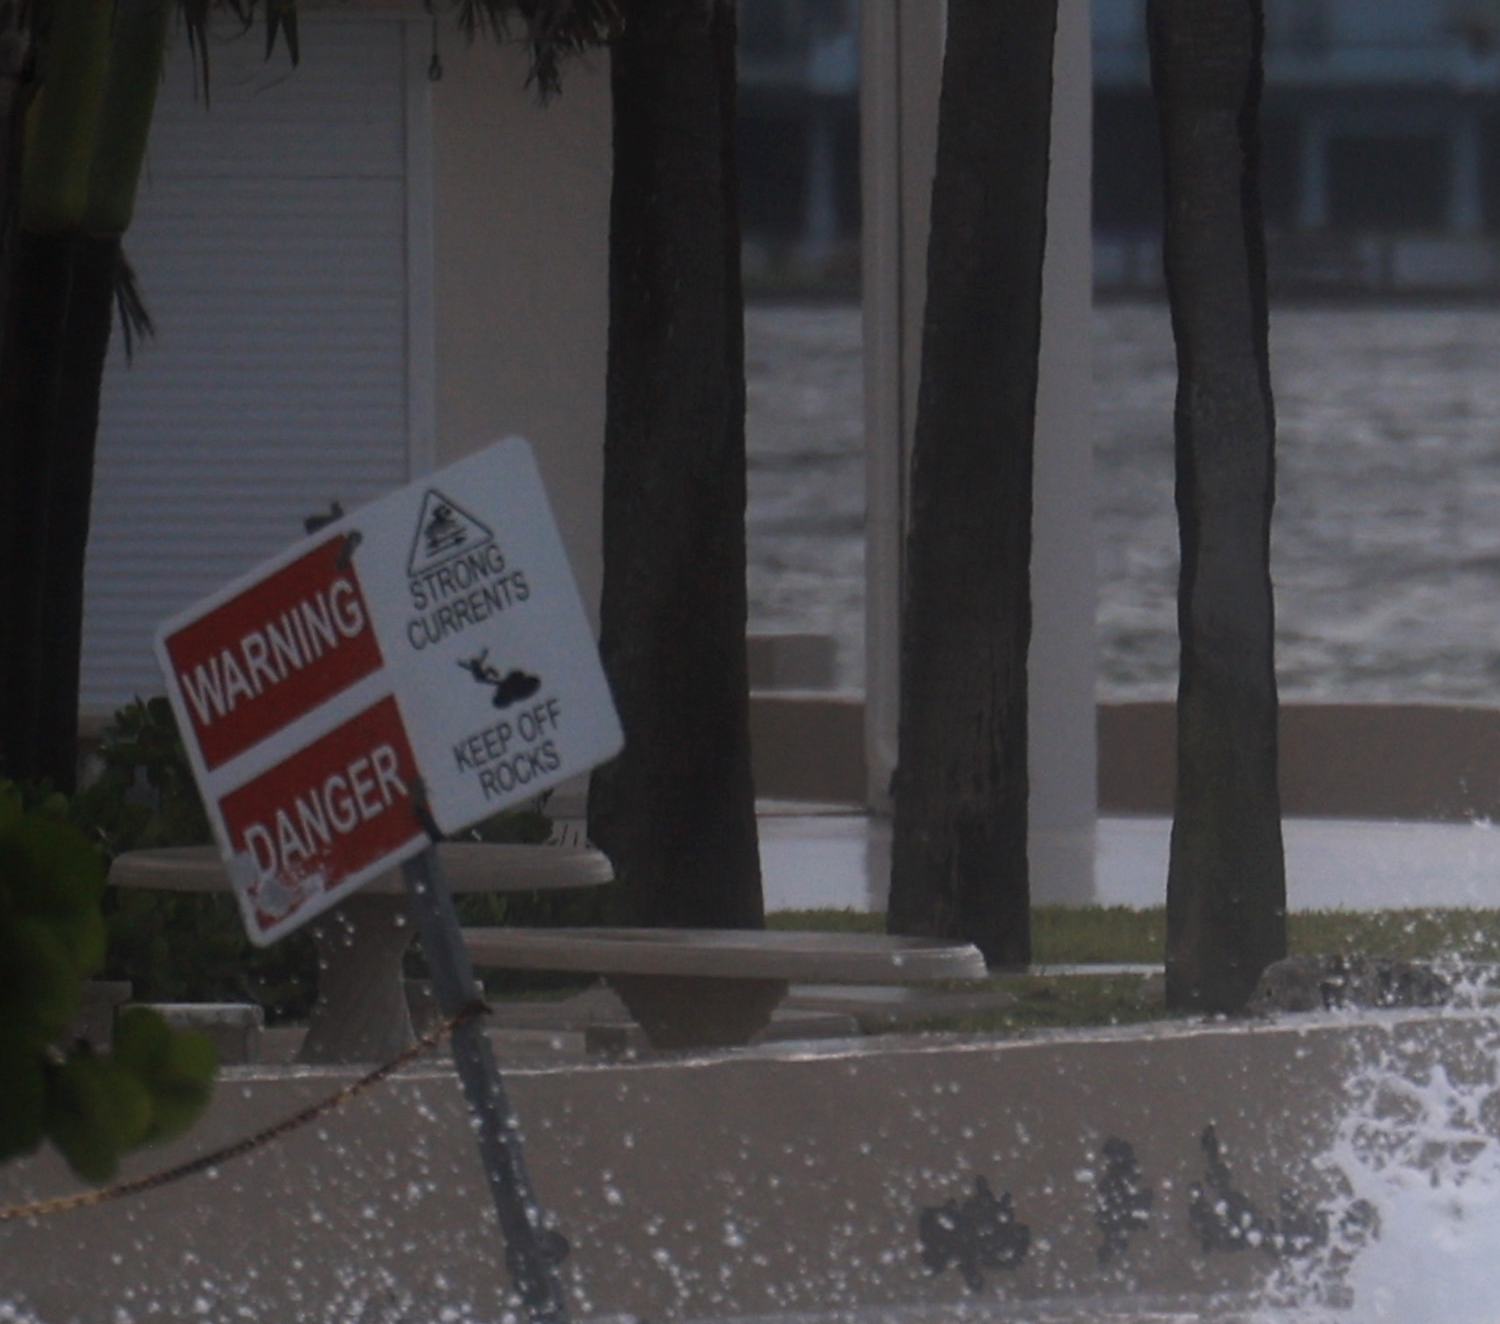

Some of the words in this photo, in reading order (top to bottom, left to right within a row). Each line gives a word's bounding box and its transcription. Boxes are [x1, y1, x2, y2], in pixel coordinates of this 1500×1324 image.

[408, 571, 530, 649] CURRENTS
[410, 545, 505, 610] STRONG
[182, 580, 364, 724] WARNING
[453, 724, 511, 773] KEEP
[518, 697, 562, 738] OFF
[481, 741, 561, 801] ROCKS
[245, 745, 407, 876] DANGER
